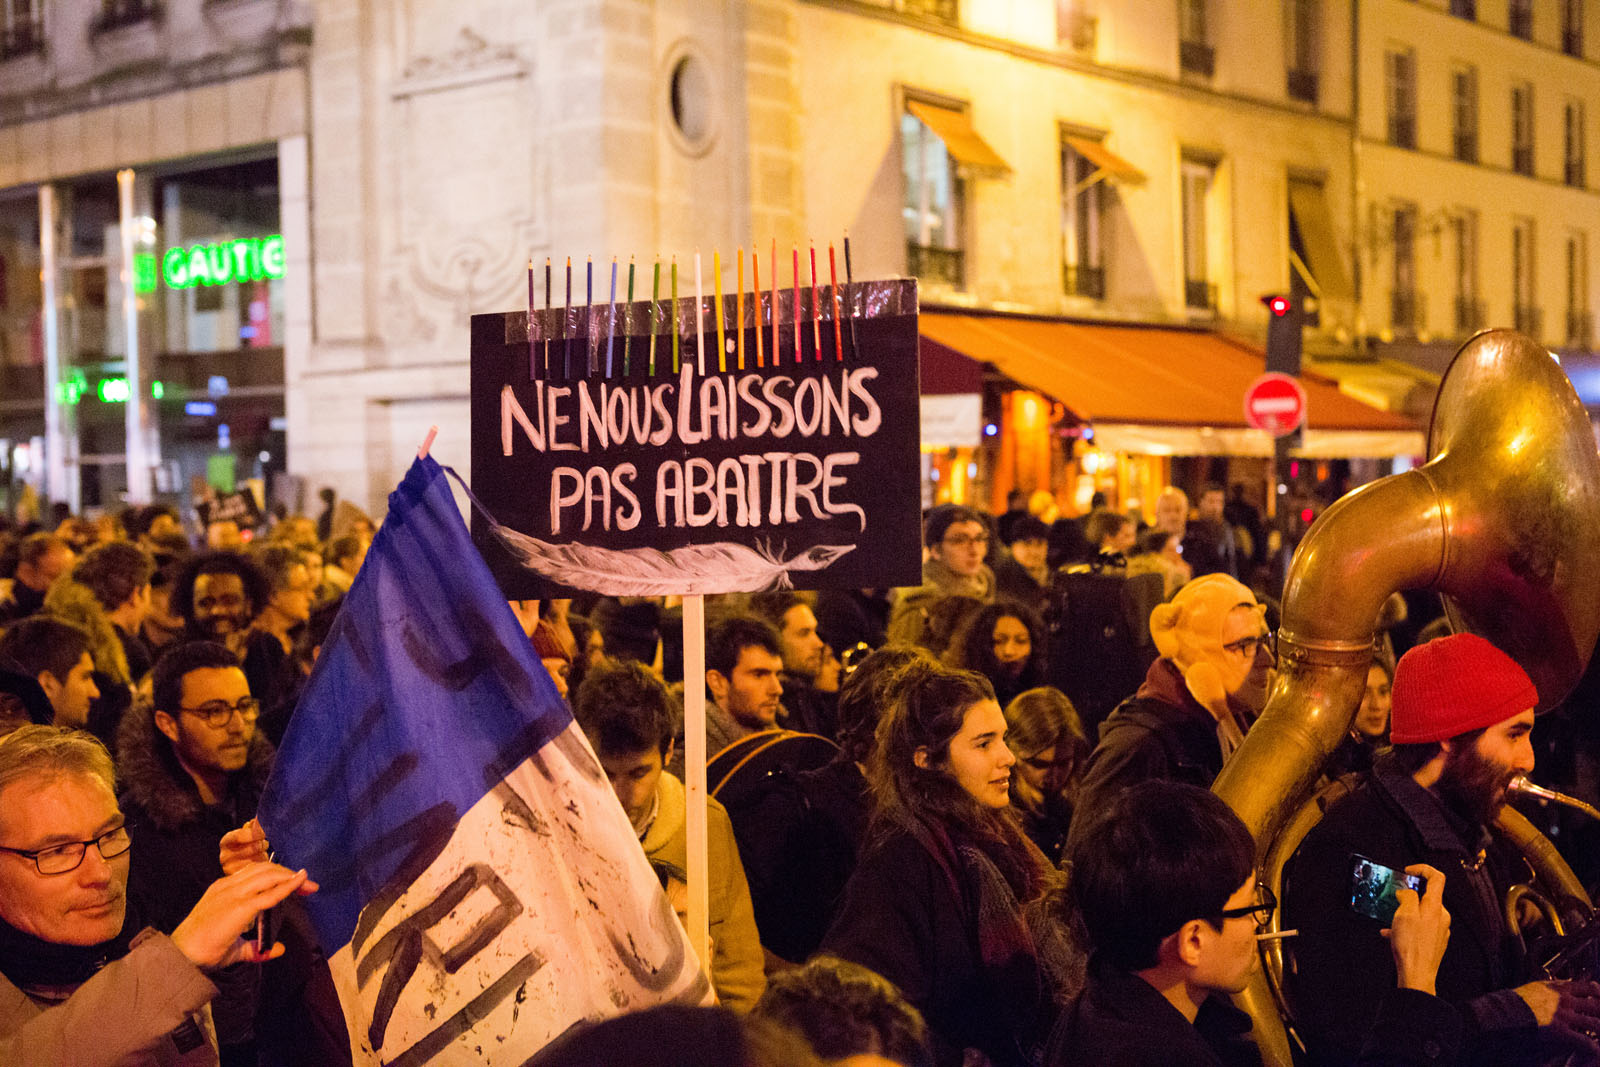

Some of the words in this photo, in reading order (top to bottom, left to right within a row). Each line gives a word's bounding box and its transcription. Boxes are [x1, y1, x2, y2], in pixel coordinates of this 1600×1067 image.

[501, 379, 580, 456] NE
[579, 379, 675, 453] NOUS
[677, 363, 882, 444] LAISSONS
[551, 462, 642, 535] PAS
[656, 452, 866, 534] ABATTRE
